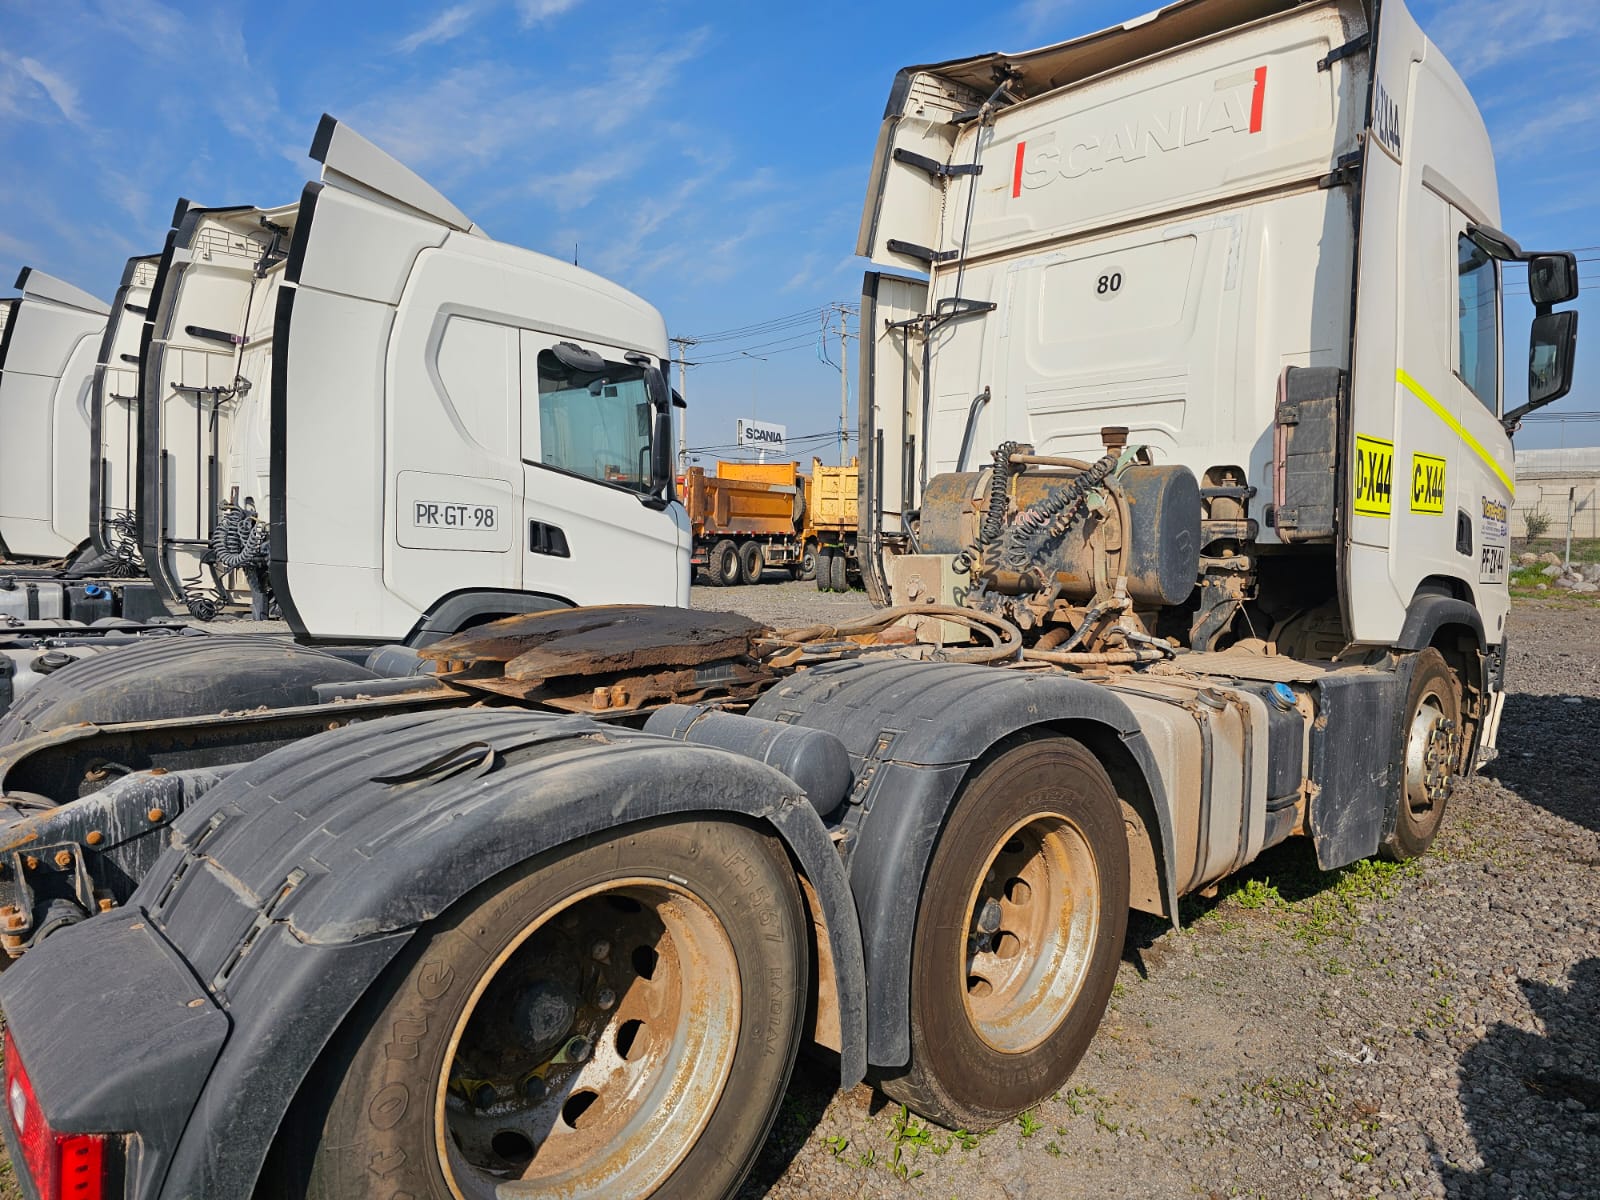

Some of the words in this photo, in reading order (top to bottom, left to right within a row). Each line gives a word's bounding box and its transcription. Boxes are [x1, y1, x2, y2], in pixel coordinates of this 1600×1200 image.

[1021, 90, 1250, 190] SCANIA
[1097, 272, 1122, 294] 80
[745, 427, 783, 444] SCANIA
[1356, 448, 1393, 504] D-X44
[1413, 463, 1444, 505] C-X44
[367, 958, 456, 1200] tone
